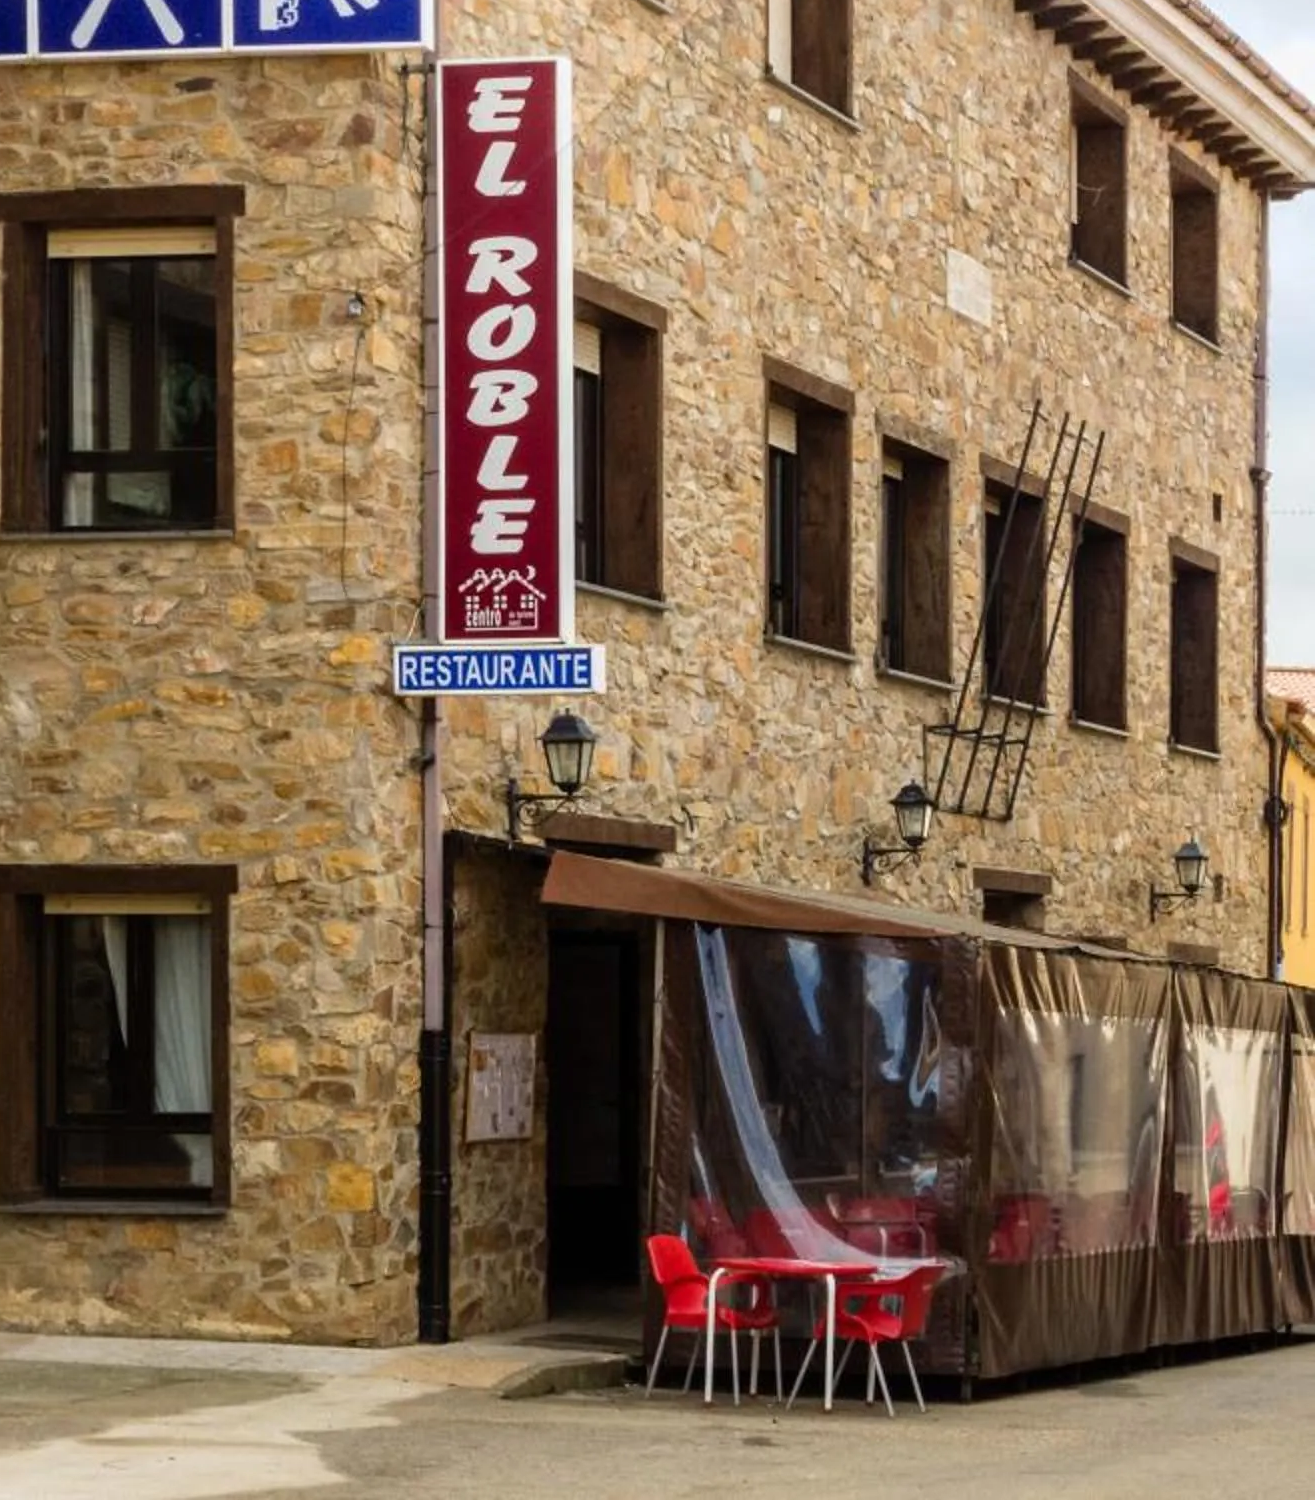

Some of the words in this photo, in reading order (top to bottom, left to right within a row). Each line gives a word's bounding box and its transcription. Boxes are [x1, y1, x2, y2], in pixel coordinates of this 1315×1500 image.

[467, 76, 534, 196] EL
[465, 236, 538, 555] ROBLE
[401, 653, 589, 687] RESTAURANTE
